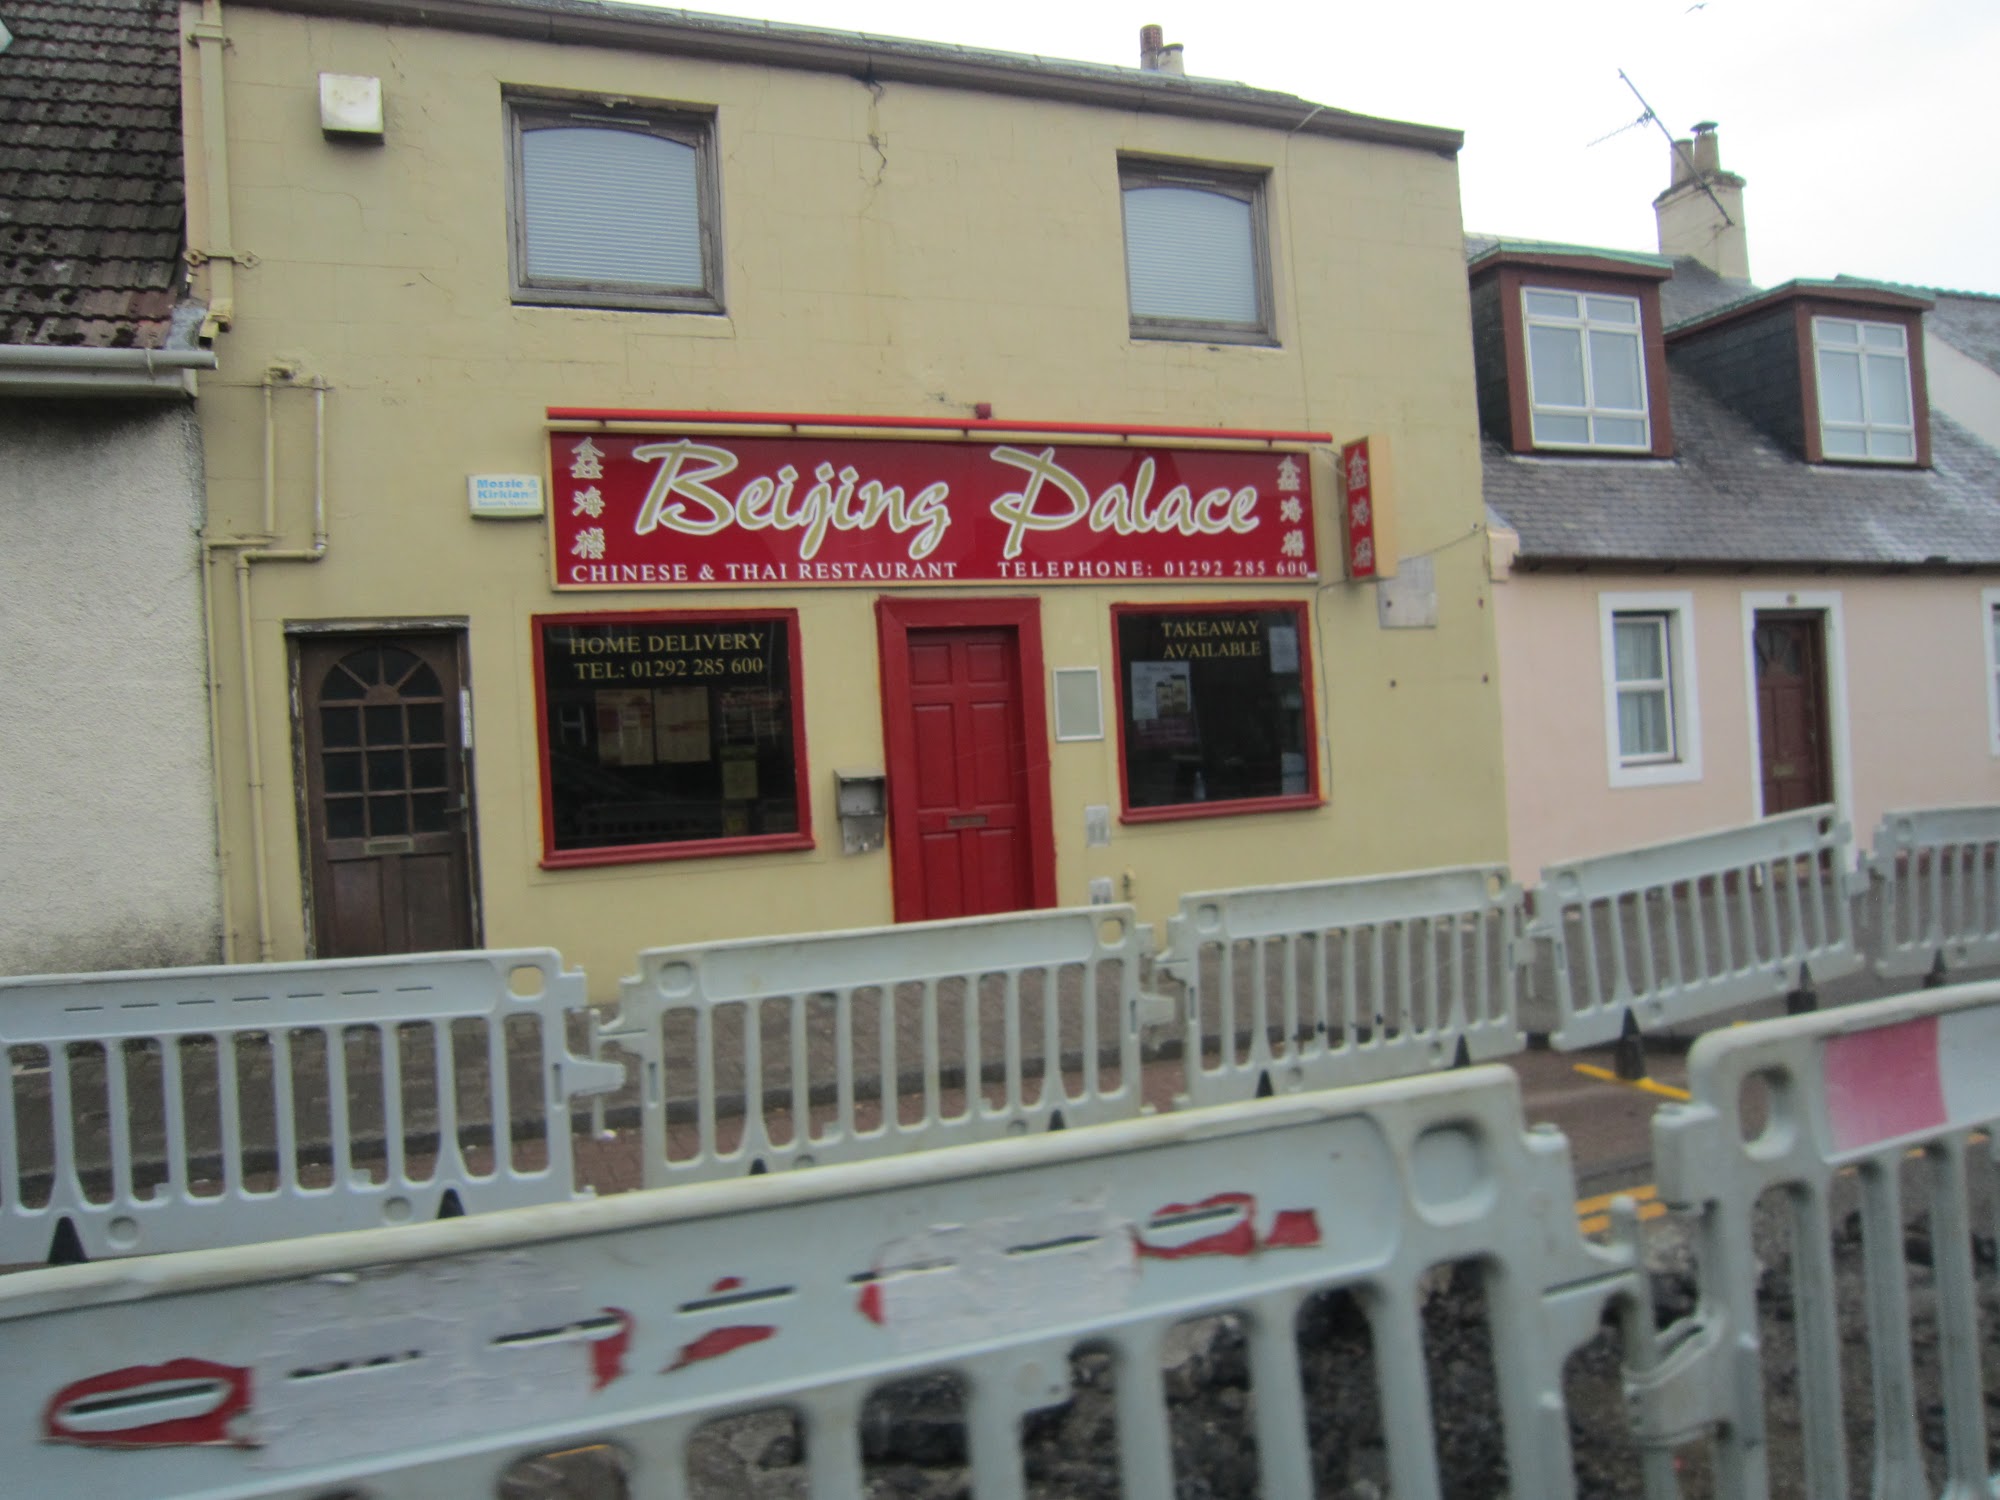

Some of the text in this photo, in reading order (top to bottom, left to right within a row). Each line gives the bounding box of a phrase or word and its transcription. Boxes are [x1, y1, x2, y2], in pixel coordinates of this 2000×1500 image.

[632, 438, 1260, 560] Beijing Palace
[571, 562, 958, 582] CHINESE & THAI RESTAURANT
[998, 560, 1308, 578] TELEPHONE: 01292 285 600
[1161, 620, 1260, 637] TAKEAWAY
[570, 633, 764, 655] HOME DELIVERY
[1163, 641, 1262, 659] AVAILABLE
[574, 657, 763, 680] TEL: 01292 285 600
